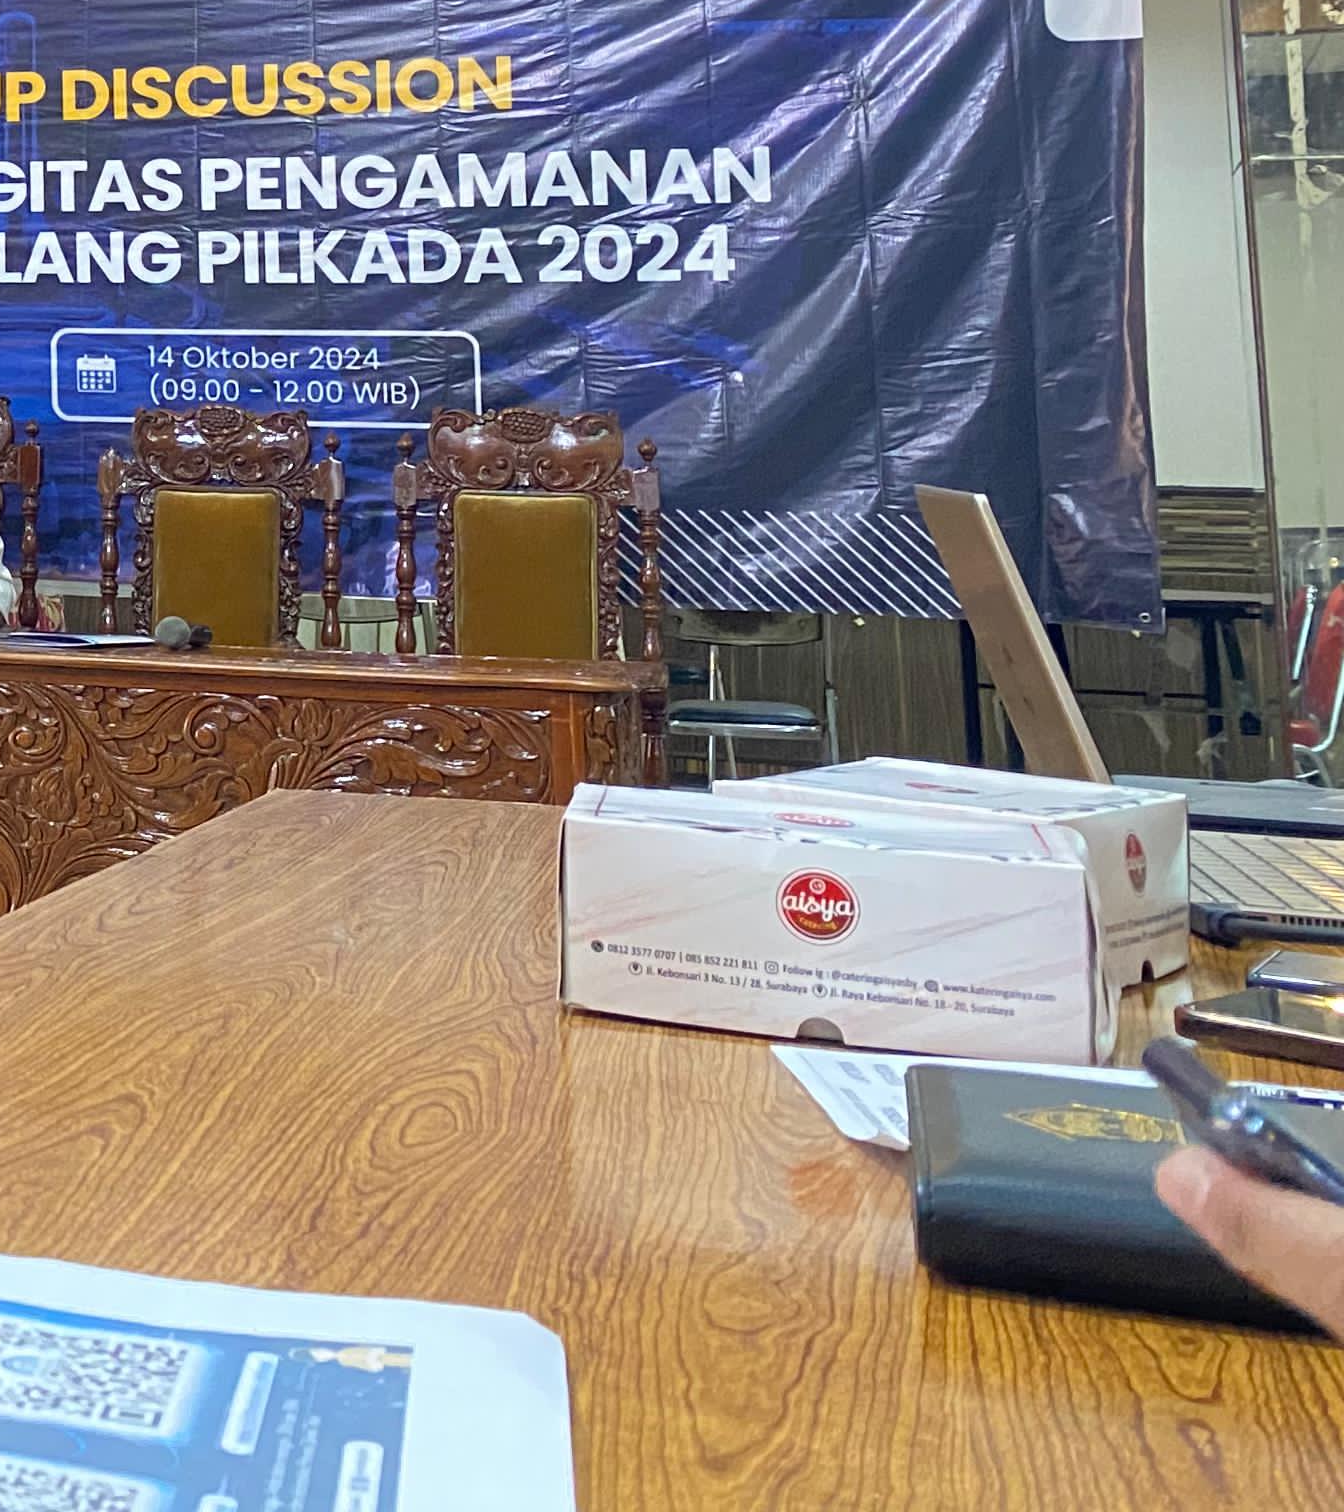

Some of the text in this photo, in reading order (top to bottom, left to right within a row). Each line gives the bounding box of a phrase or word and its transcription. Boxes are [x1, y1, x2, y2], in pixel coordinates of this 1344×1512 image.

[60, 55, 515, 121] DISCUSSION
[199, 145, 773, 212] PENGAMANAN
[198, 226, 525, 284] PILKADA
[537, 222, 737, 283] 2024
[147, 345, 381, 370] 14 Oktober 2024
[150, 372, 241, 406] (09.00
[273, 379, 344, 404] 12.00
[352, 374, 421, 410] WIB)
[782, 891, 854, 922] aisya
[607, 943, 629, 955] 0812
[631, 946, 653, 958] 3577
[722, 958, 739, 969] 221
[765, 979, 808, 996] Surabaya
